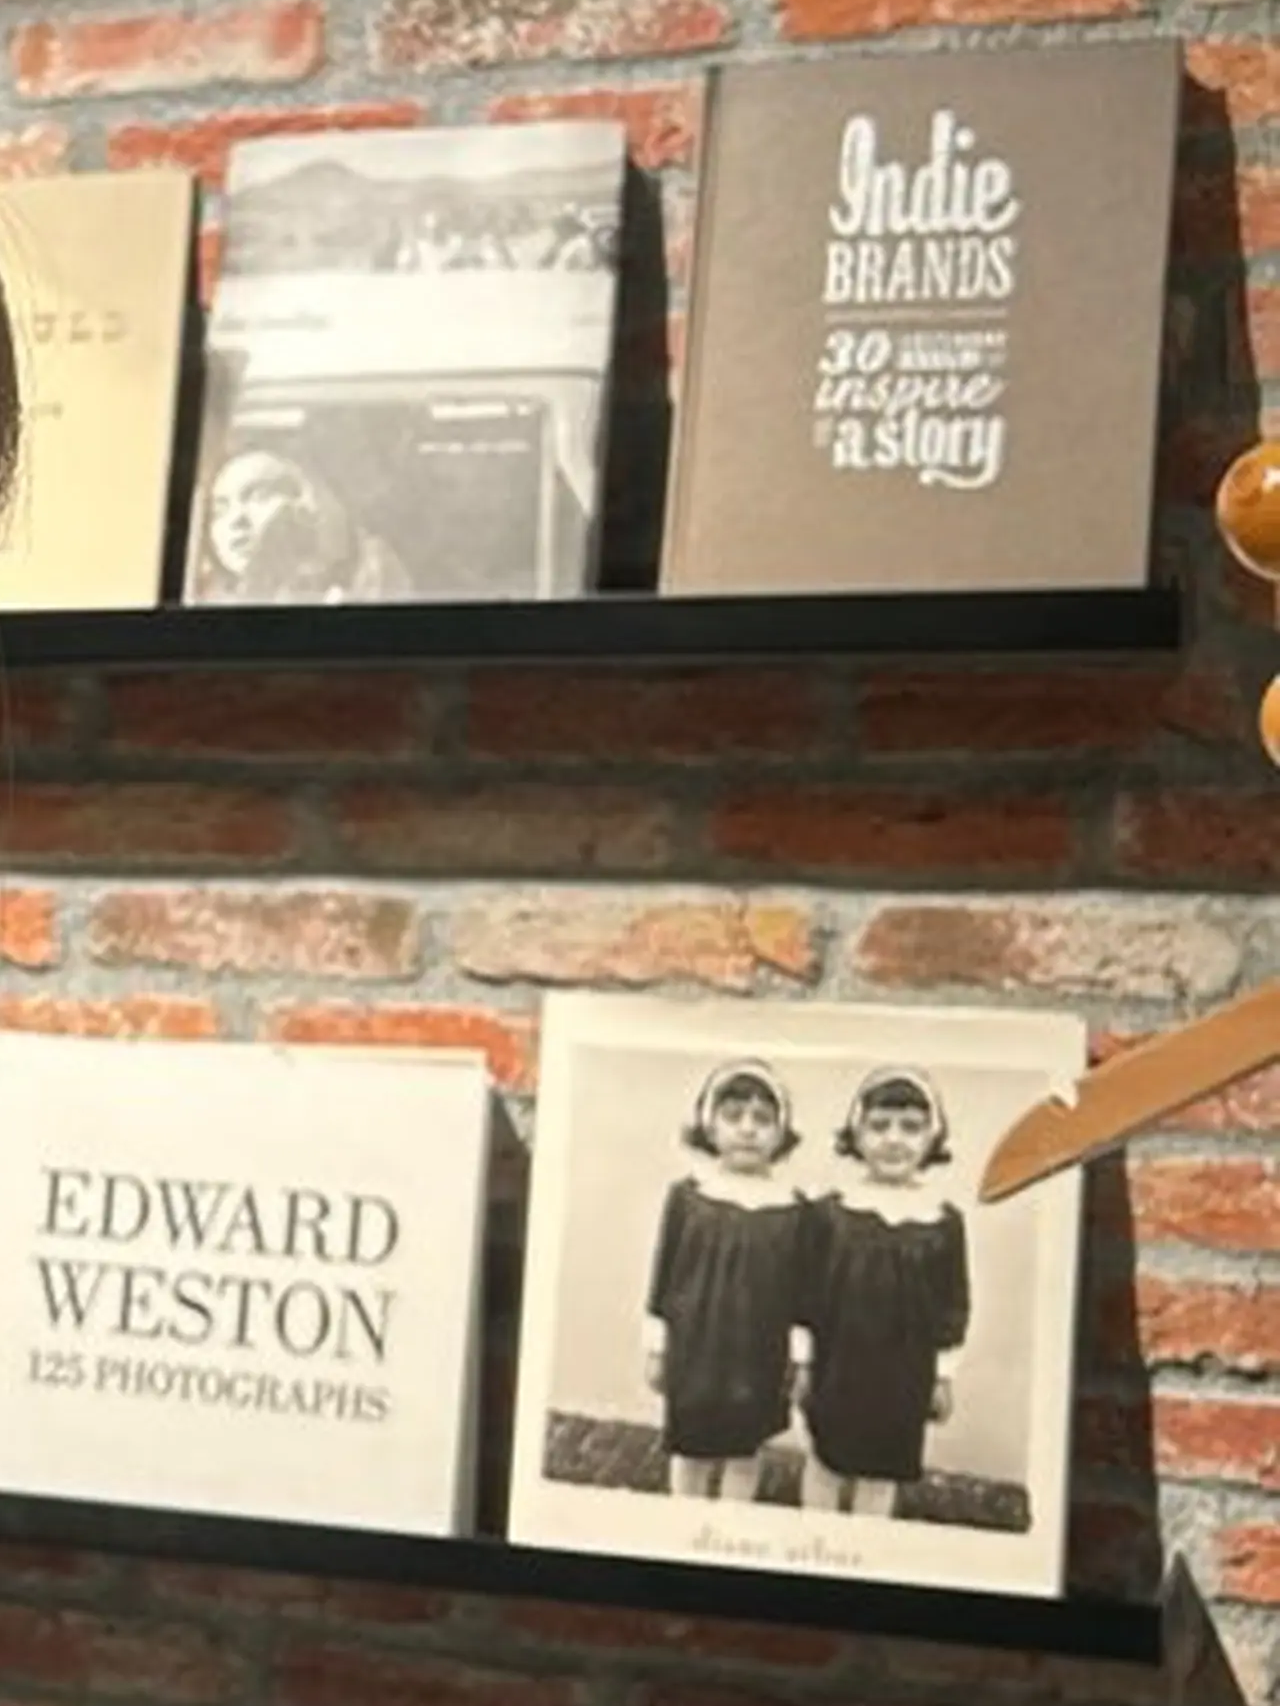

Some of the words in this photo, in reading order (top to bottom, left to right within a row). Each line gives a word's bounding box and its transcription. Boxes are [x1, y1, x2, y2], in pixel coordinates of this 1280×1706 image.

[828, 108, 1022, 238] Indie
[820, 236, 1018, 304] BRANDS
[817, 329, 892, 376] 30
[833, 416, 871, 469] a
[871, 405, 1008, 490] story
[37, 1165, 400, 1267] EDWARD
[28, 1256, 399, 1363] WESTON
[28, 1347, 88, 1389] 125
[92, 1353, 394, 1423] PHOTOGRAPHS
